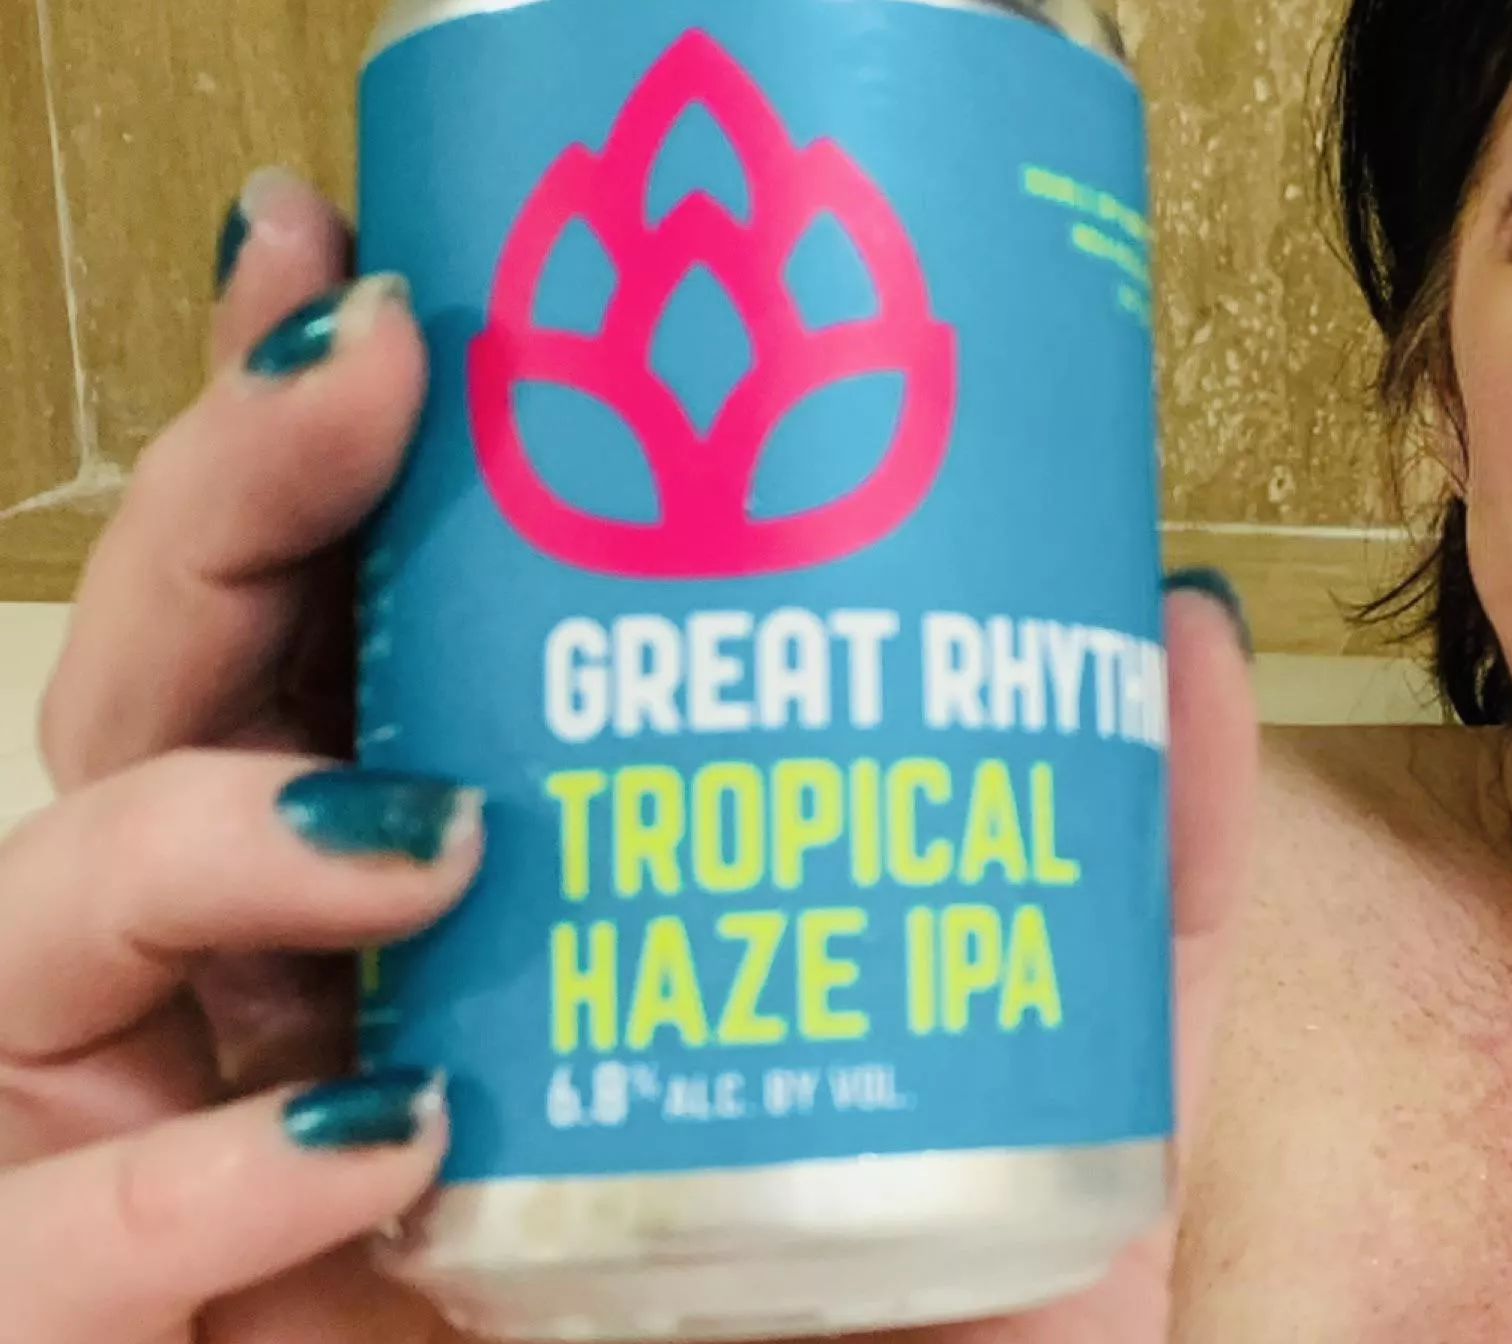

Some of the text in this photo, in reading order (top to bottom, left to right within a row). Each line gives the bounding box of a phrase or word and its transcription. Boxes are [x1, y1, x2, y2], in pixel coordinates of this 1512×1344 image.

[545, 607, 900, 742] GREAT
[921, 611, 1169, 752] RHYTH
[546, 757, 1081, 901] TROPICAL
[551, 904, 1062, 1053] HAZE IPA
[762, 1067, 821, 1117] BY
